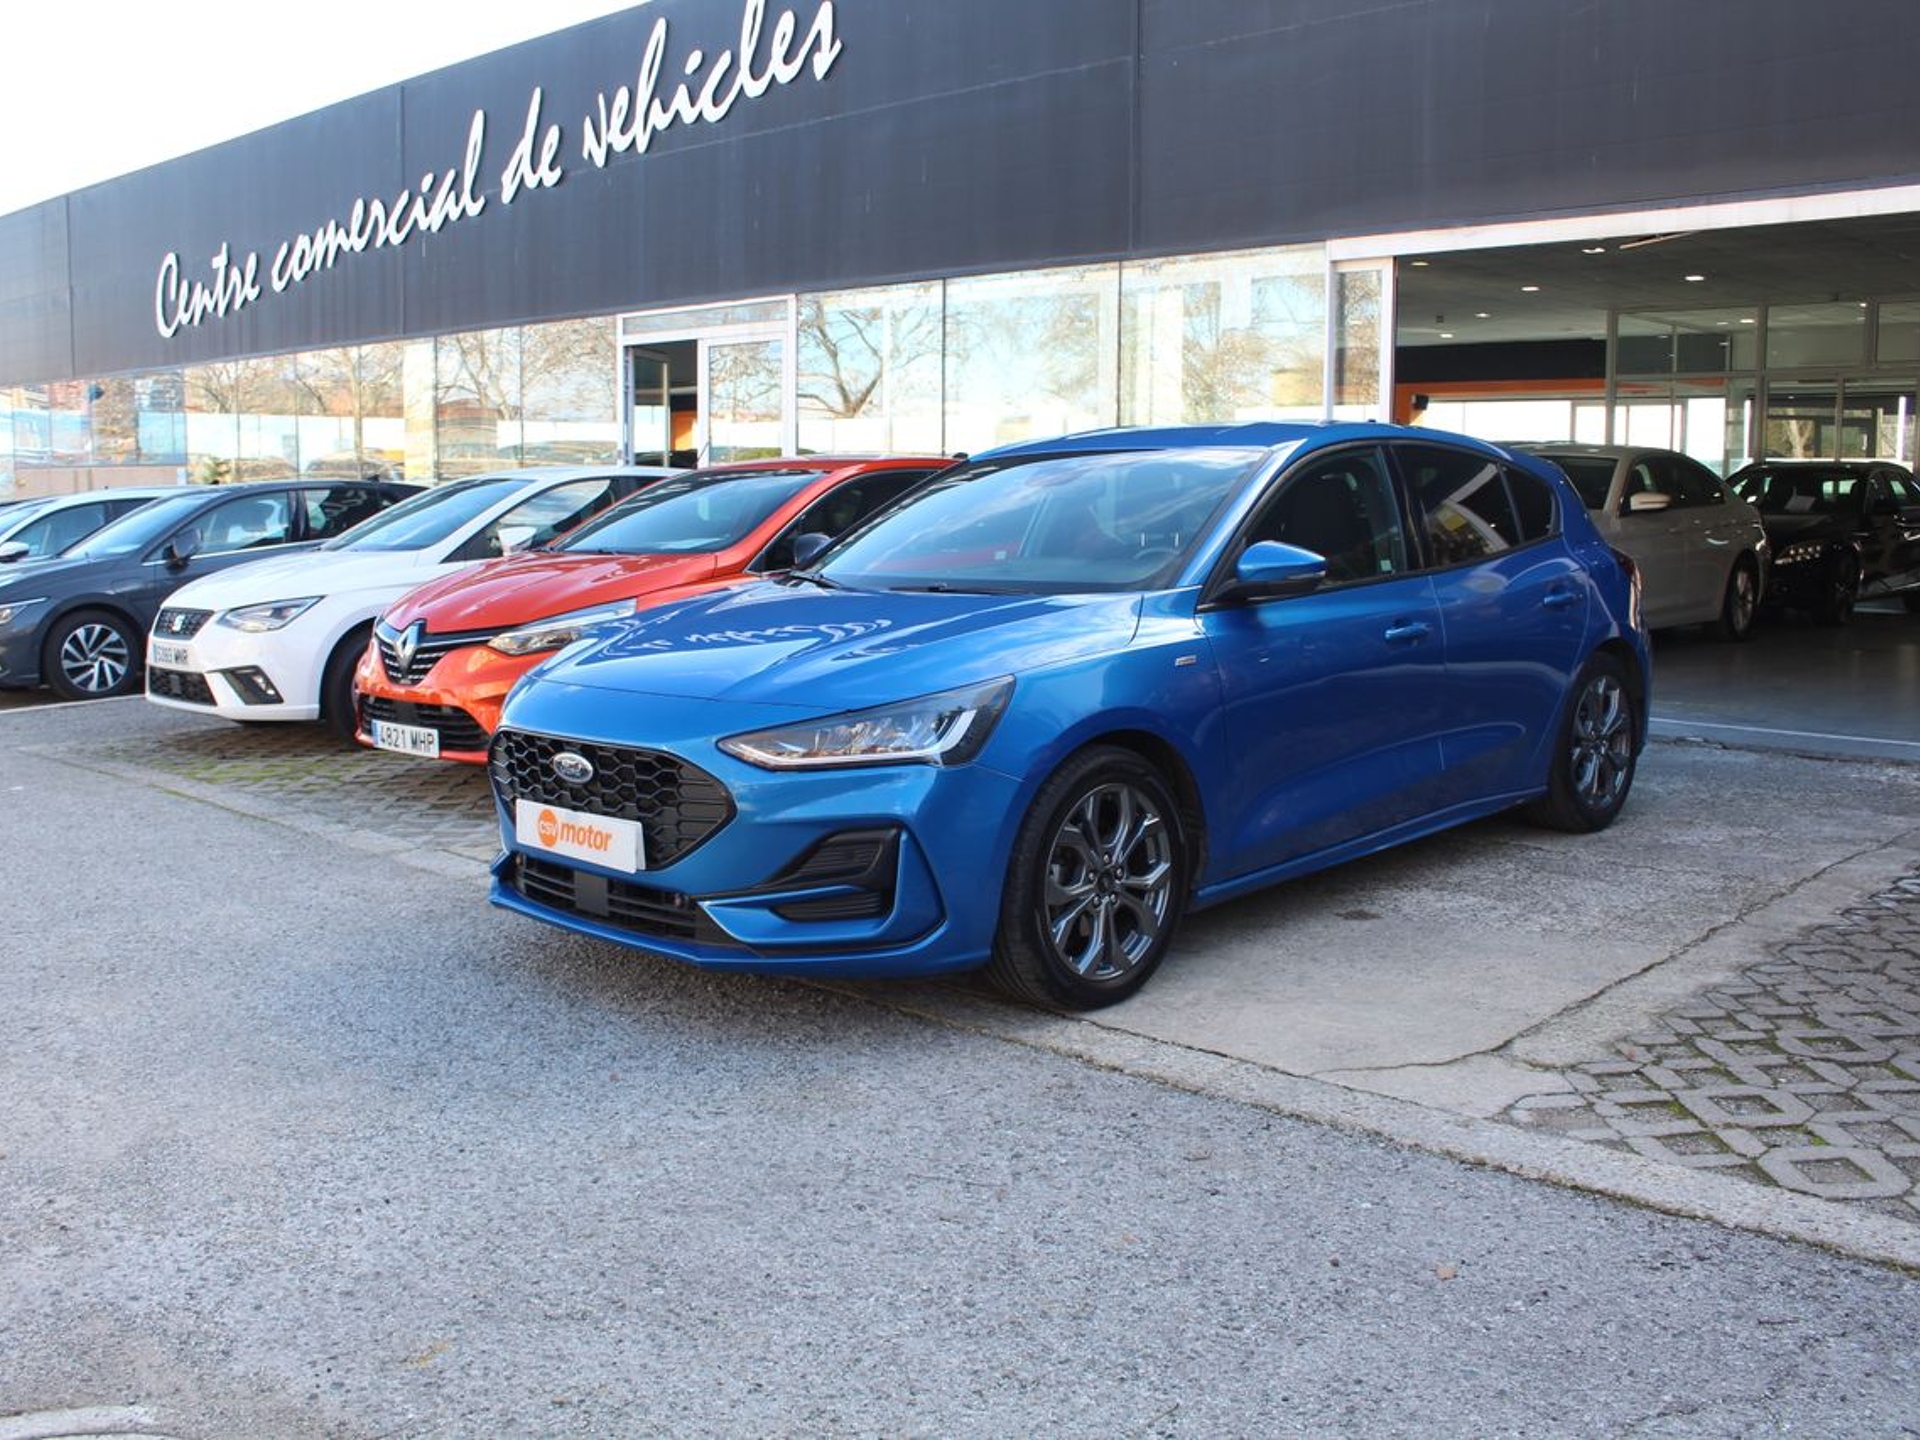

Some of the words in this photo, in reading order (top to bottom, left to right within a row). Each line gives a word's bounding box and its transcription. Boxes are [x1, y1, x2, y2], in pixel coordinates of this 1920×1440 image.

[155, 242, 260, 338] Centre
[271, 109, 486, 293] comercial
[501, 86, 562, 205] de
[582, 0, 843, 168] vehicles
[380, 724, 408, 750] 4821
[410, 729, 435, 754] MHP
[560, 822, 612, 852] motor
